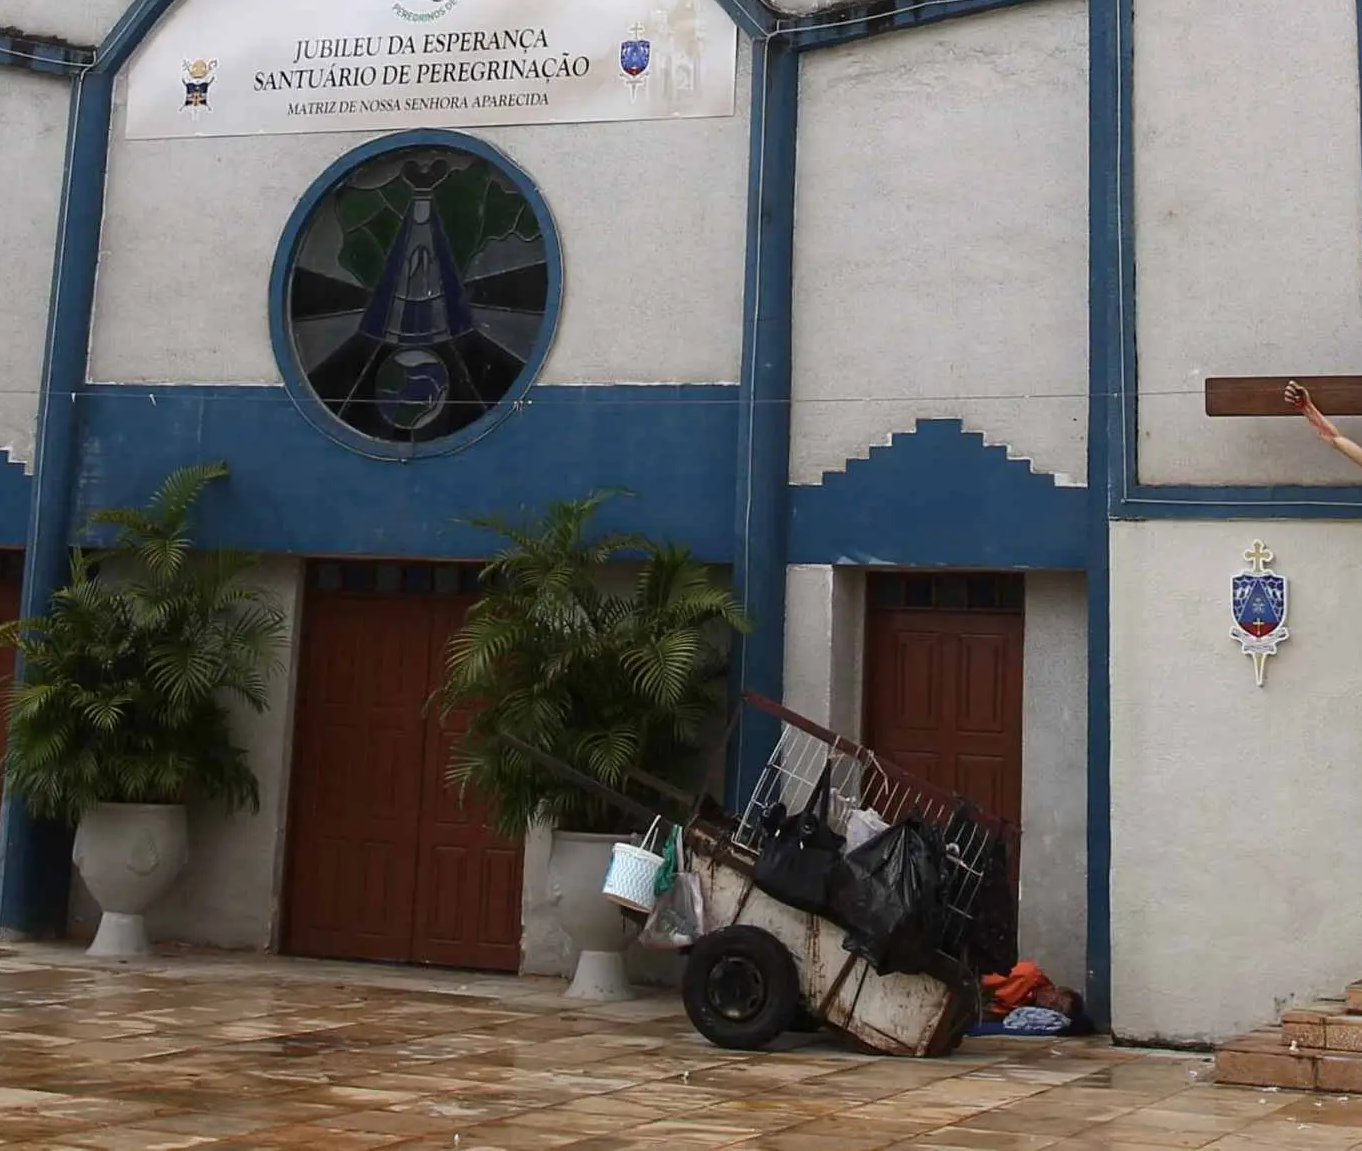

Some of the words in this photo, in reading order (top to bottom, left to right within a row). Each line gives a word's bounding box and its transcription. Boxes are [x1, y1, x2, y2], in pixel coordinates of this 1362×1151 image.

[293, 36, 382, 64] JUBILEU
[387, 34, 416, 56] DA
[423, 29, 549, 54] ESPERANÇA
[253, 63, 377, 92] SANTUÁRIO
[382, 64, 411, 86] DE
[416, 52, 590, 84] PEREGRINAÇÃO
[287, 101, 337, 116] MATRIZ
[339, 100, 356, 114] DE
[359, 98, 400, 113] NOSSA
[404, 96, 468, 111] SENHORA
[471, 92, 549, 109] APARECIDA
